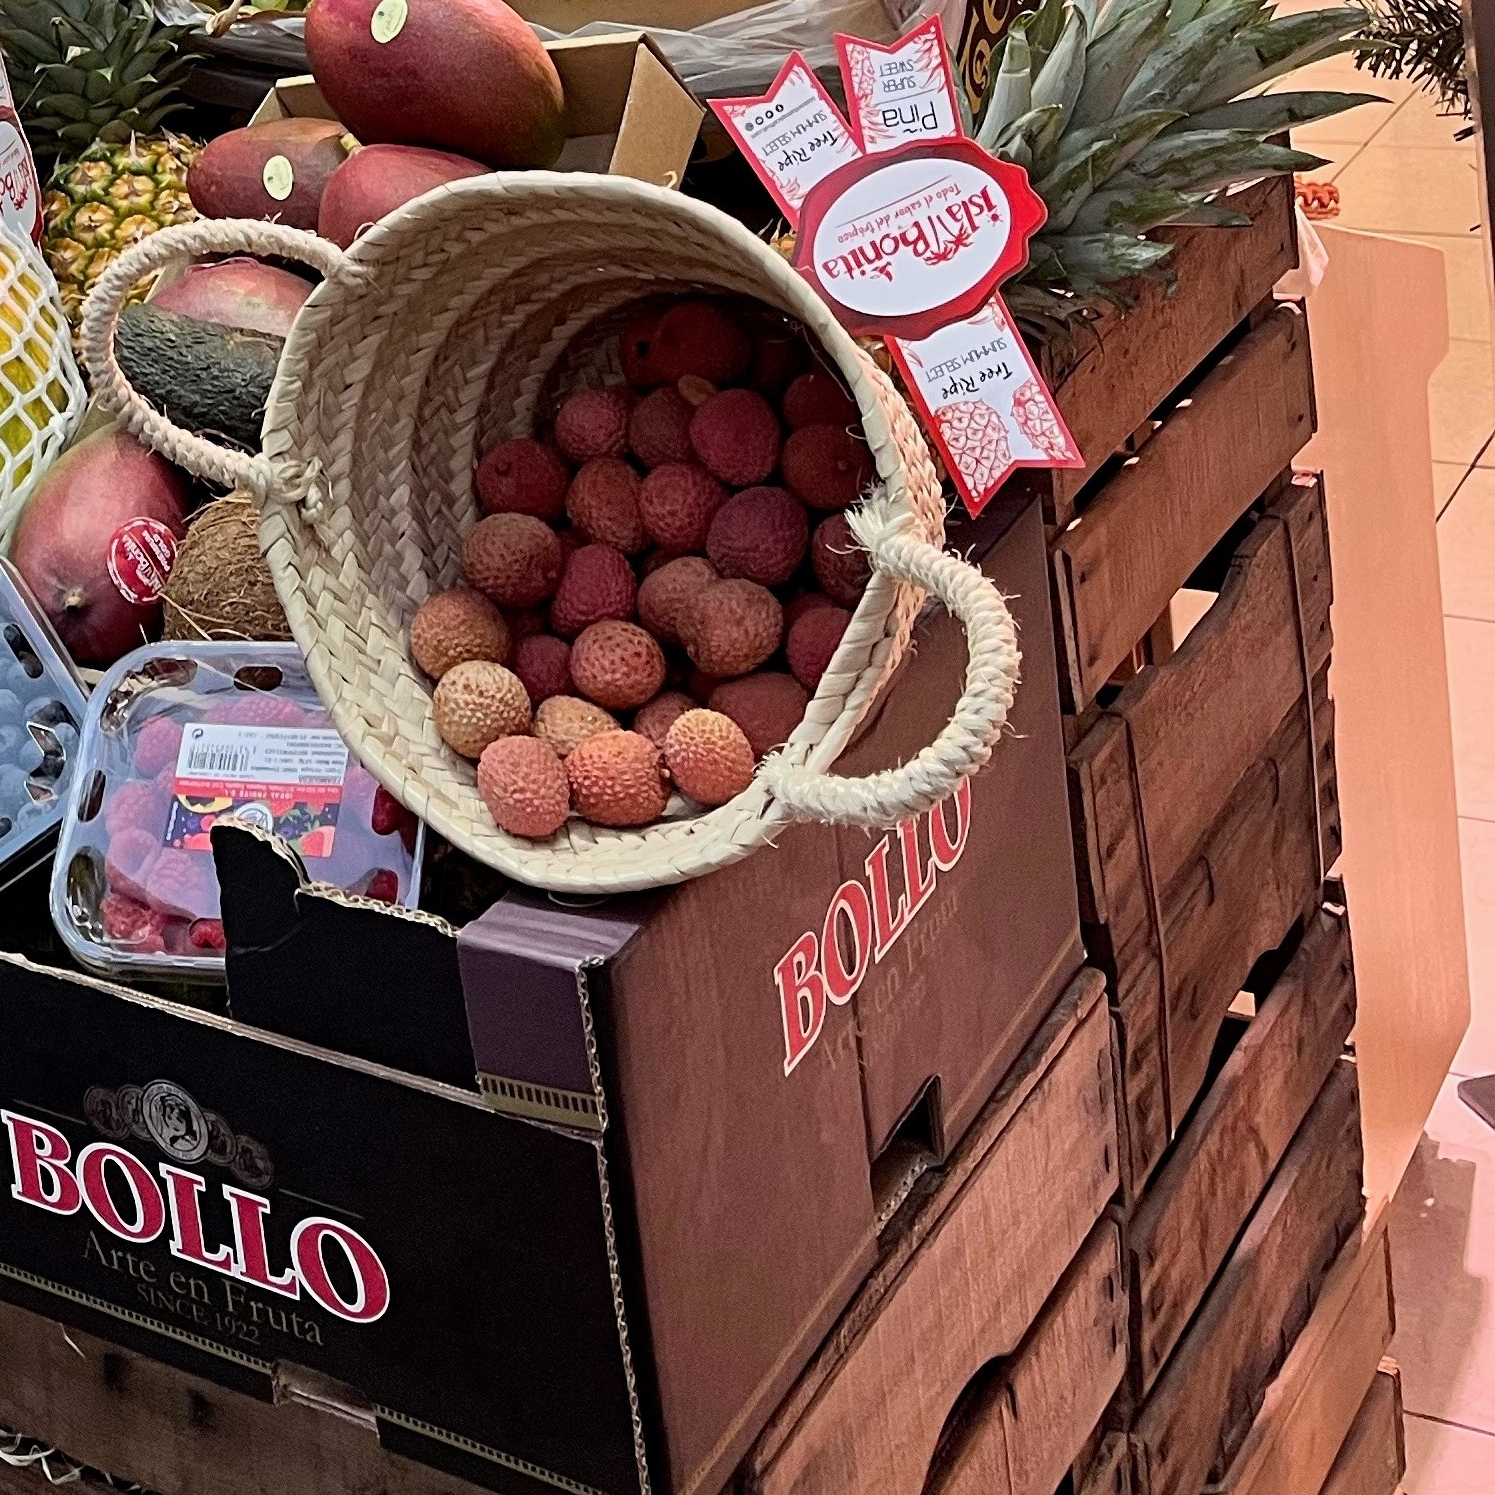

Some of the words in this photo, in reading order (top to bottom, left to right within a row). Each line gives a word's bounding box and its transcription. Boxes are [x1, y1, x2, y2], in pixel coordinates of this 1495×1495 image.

[879, 59, 916, 78] SWEET
[882, 76, 916, 93] SUPER
[881, 99, 939, 136] Piña
[762, 131, 792, 157] SELECT
[808, 130, 838, 152] Tree
[777, 147, 812, 172] Ripe
[923, 194, 934, 205] el
[936, 183, 962, 201] Todo
[875, 214, 891, 227] del
[894, 199, 922, 219] sabor
[837, 220, 875, 244] trópico
[821, 220, 931, 281] Bonita
[925, 356, 962, 383] SELECT
[979, 361, 1013, 383] Tree
[941, 375, 980, 400] Ripe
[774, 773, 972, 1078] BOLLO
[0, 1108, 391, 1324] BOLLO
[83, 1229, 157, 1284] Arte
[169, 1270, 212, 1306] en
[222, 1278, 326, 1348] Fruta
[135, 1282, 207, 1326] SINCE
[214, 1312, 262, 1347] 1922
